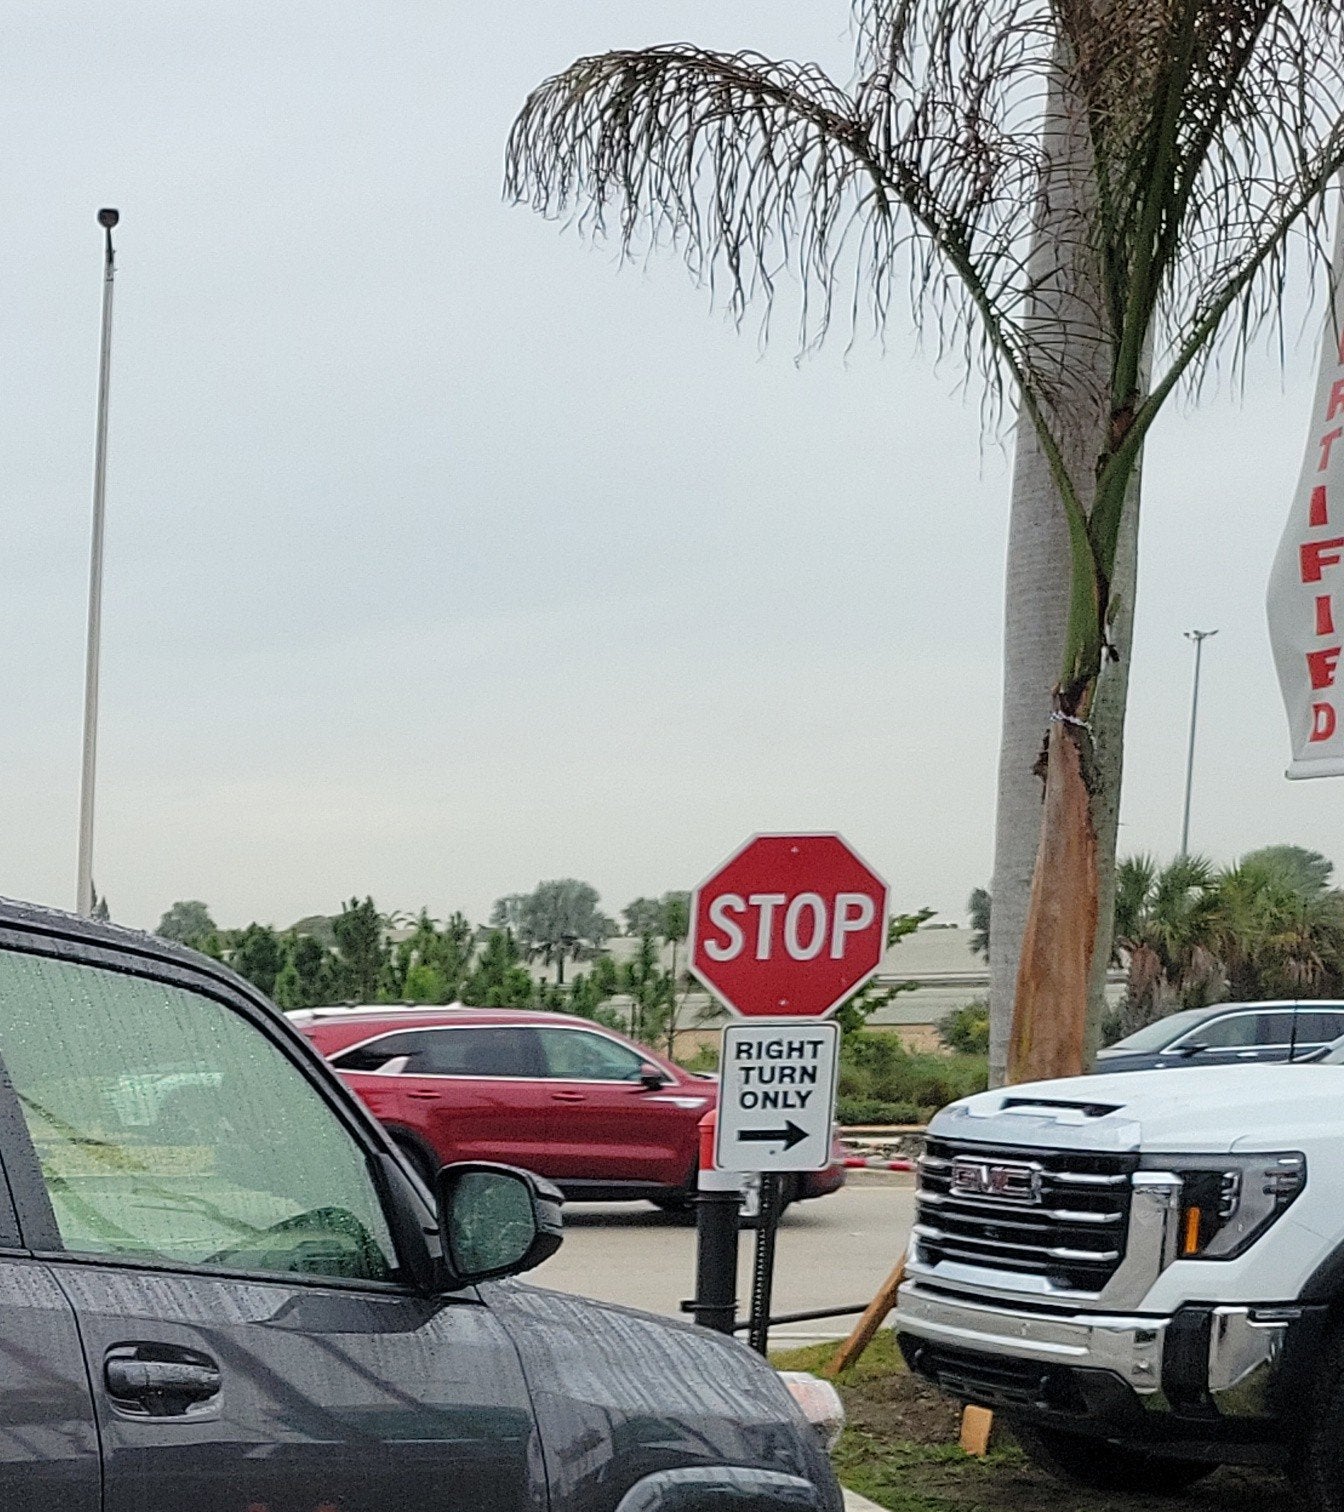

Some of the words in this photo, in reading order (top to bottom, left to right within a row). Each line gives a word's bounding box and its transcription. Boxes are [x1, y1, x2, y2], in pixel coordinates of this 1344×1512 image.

[1299, 325, 1344, 743] RTIFIED
[703, 891, 876, 962] STOP
[734, 1039, 825, 1062] RIGHT
[738, 1065, 818, 1085] TURN
[739, 1090, 813, 1110] ONLY
[950, 1157, 1042, 1204] GMC
